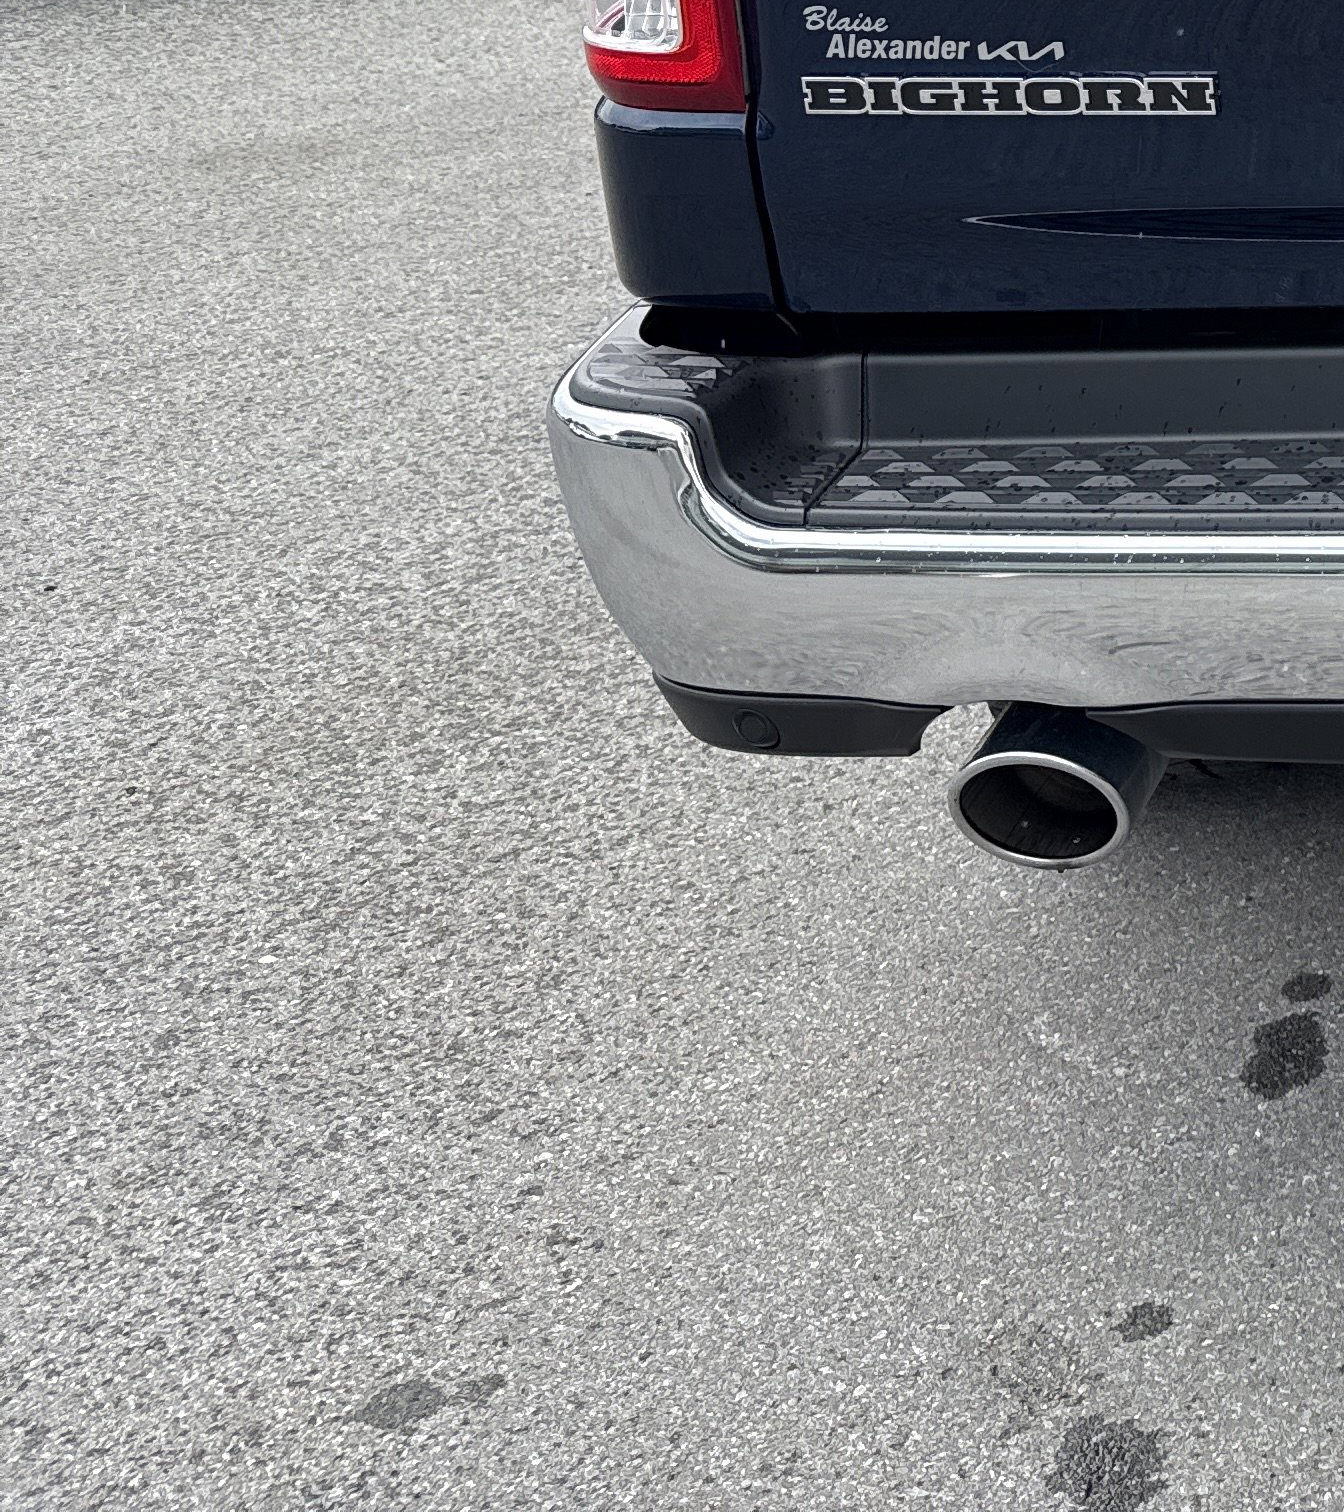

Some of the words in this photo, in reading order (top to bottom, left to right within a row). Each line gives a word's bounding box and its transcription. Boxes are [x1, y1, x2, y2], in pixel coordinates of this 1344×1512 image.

[802, 5, 889, 33] Blaise
[826, 33, 970, 61] Alexander
[800, 76, 1218, 116] BIGHORN
